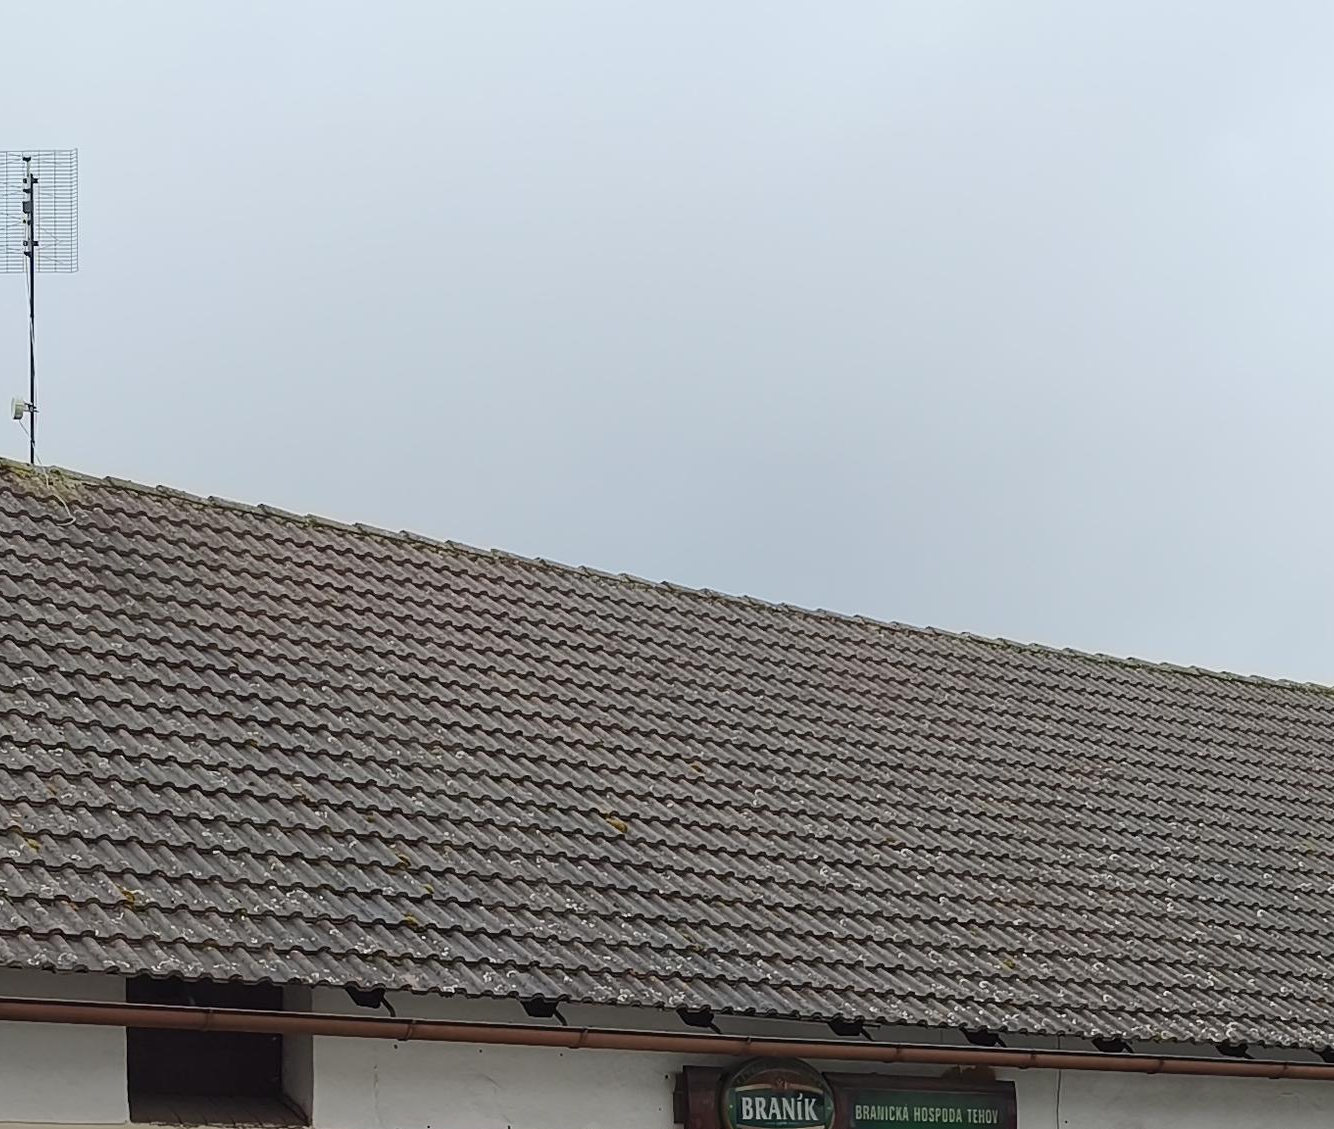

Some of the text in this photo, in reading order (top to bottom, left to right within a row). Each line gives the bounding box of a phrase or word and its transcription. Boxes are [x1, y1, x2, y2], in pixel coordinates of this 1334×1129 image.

[741, 1093, 820, 1121] BRANÍK
[854, 1104, 999, 1124] BRANICKÁ HOSPODA TEHOV
